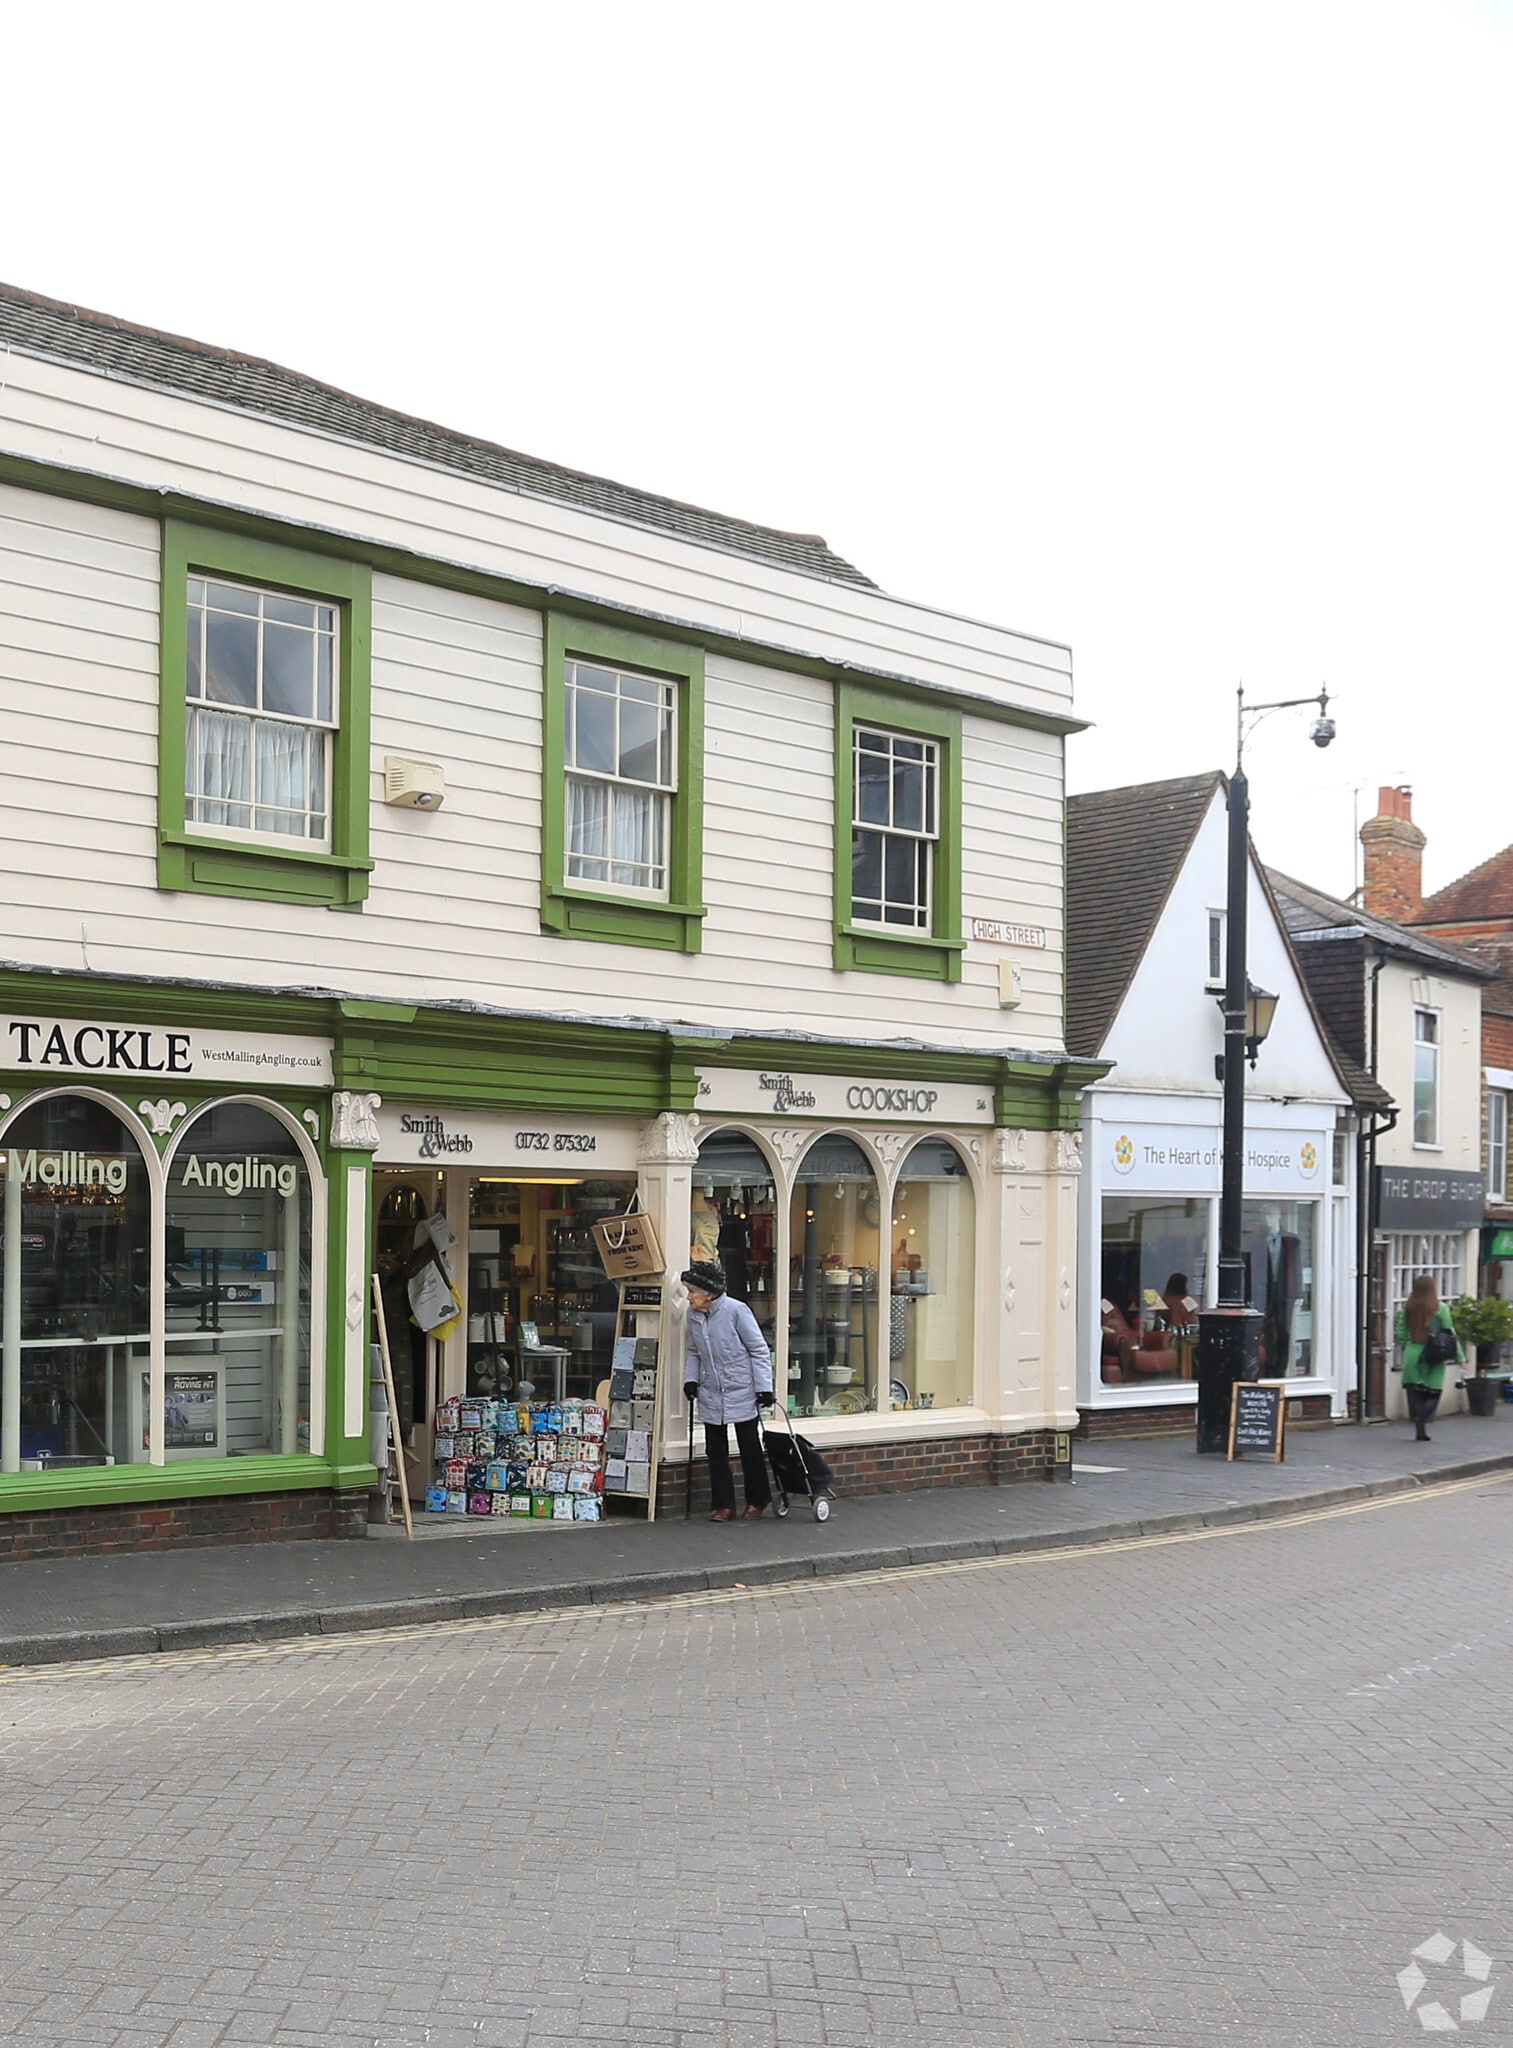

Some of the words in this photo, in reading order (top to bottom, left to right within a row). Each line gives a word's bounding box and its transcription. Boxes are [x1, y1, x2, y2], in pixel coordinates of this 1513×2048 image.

[977, 921, 1000, 940] HIGH
[1006, 925, 1041, 945] STREET
[8, 1022, 194, 1074] TACKLE
[201, 1048, 322, 1069] WestMallingAngling.co.uk
[700, 1082, 712, 1095] 56
[758, 1072, 794, 1091] Smith
[787, 1090, 816, 1108] Webb
[846, 1085, 938, 1113] COOKSHOP
[975, 1099, 987, 1111] 56
[400, 1114, 444, 1134] Smith
[418, 1134, 441, 1159] &
[436, 1133, 473, 1153] Webb
[515, 1131, 550, 1151] 01732
[553, 1133, 596, 1152] 875324
[1144, 1146, 1166, 1164] The
[1169, 1147, 1201, 1165] Heart
[1205, 1148, 1217, 1166] of
[1248, 1150, 1291, 1171] Hospice
[7, 1149, 128, 1195] Malling
[182, 1154, 297, 1198] Angling
[1383, 1178, 1410, 1198] THE
[1414, 1180, 1447, 1199] CROP
[1451, 1182, 1482, 1201] SHOP
[628, 1244, 644, 1252] KENT
[174, 1380, 202, 1389] ROVING
[203, 1380, 215, 1389] KIT
